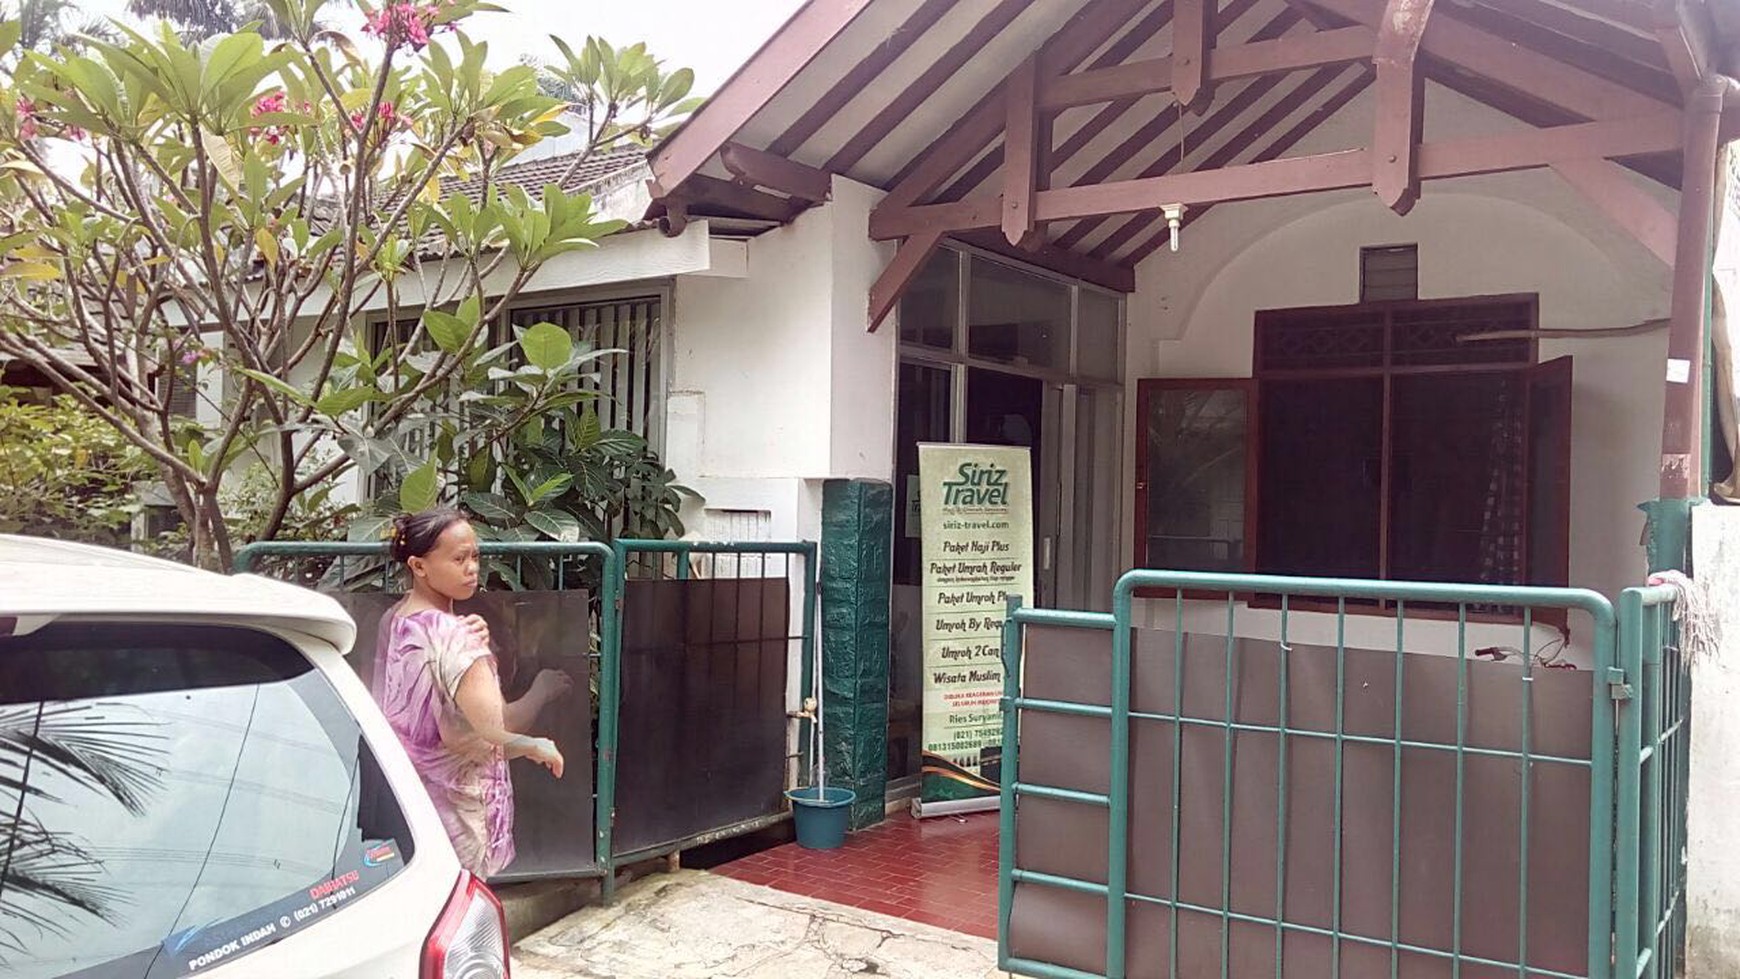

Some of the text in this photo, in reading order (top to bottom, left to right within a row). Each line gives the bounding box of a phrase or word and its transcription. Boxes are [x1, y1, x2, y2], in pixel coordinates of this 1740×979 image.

[958, 462, 1006, 486] Siriz
[943, 482, 1008, 505] Travel
[943, 520, 1009, 530] siriz-travel.com
[943, 540, 1010, 555] Paket Haji Plus
[930, 562, 956, 576] Paket
[990, 561, 1022, 575] Reguler
[938, 592, 964, 606] Paket
[968, 618, 982, 631] By
[933, 670, 1001, 684] Wisata Muslim
[949, 714, 967, 724] Ries
[310, 870, 360, 899] DAIHATSU
[188, 940, 240, 971] PONDOK
[240, 923, 277, 947] INDAH
[293, 903, 318, 921] (021)
